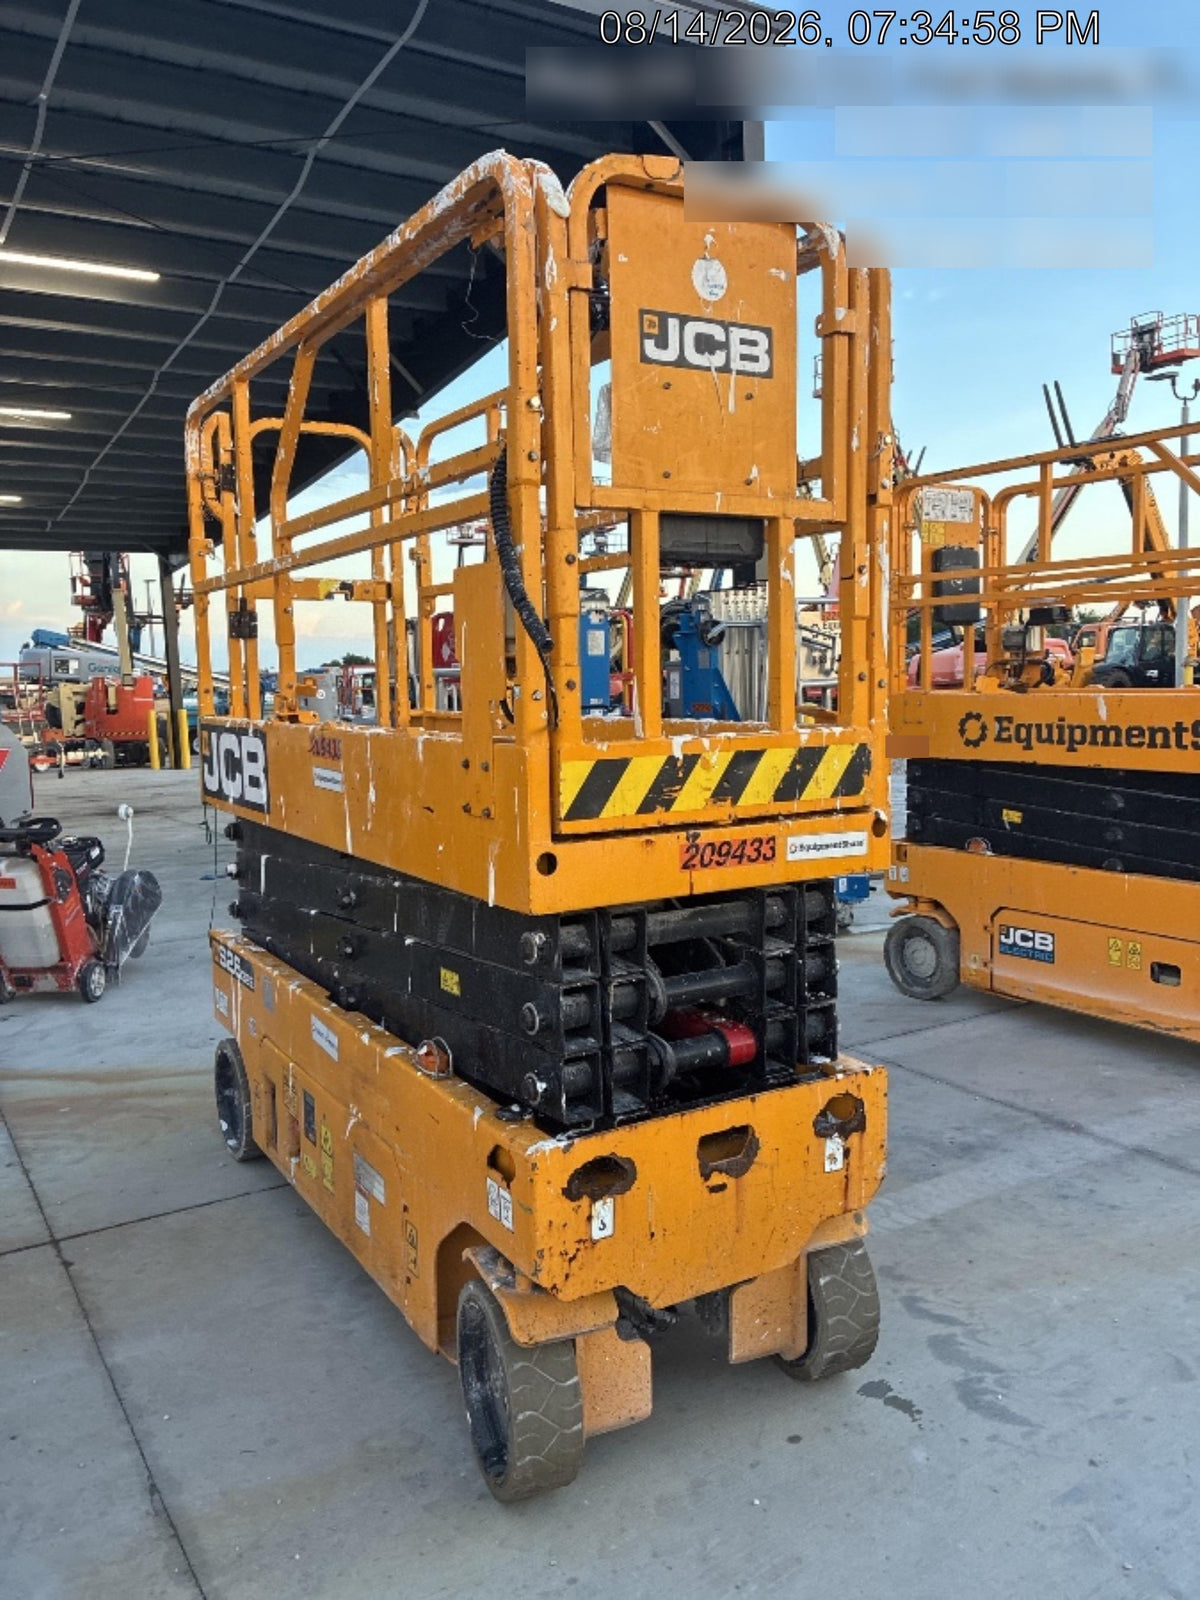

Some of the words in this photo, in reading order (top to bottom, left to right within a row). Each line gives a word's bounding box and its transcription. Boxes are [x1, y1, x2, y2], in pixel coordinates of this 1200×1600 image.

[643, 318, 771, 373] JCB
[203, 732, 267, 804] JCB
[681, 835, 776, 870] 209433
[1000, 927, 1053, 952] JCB
